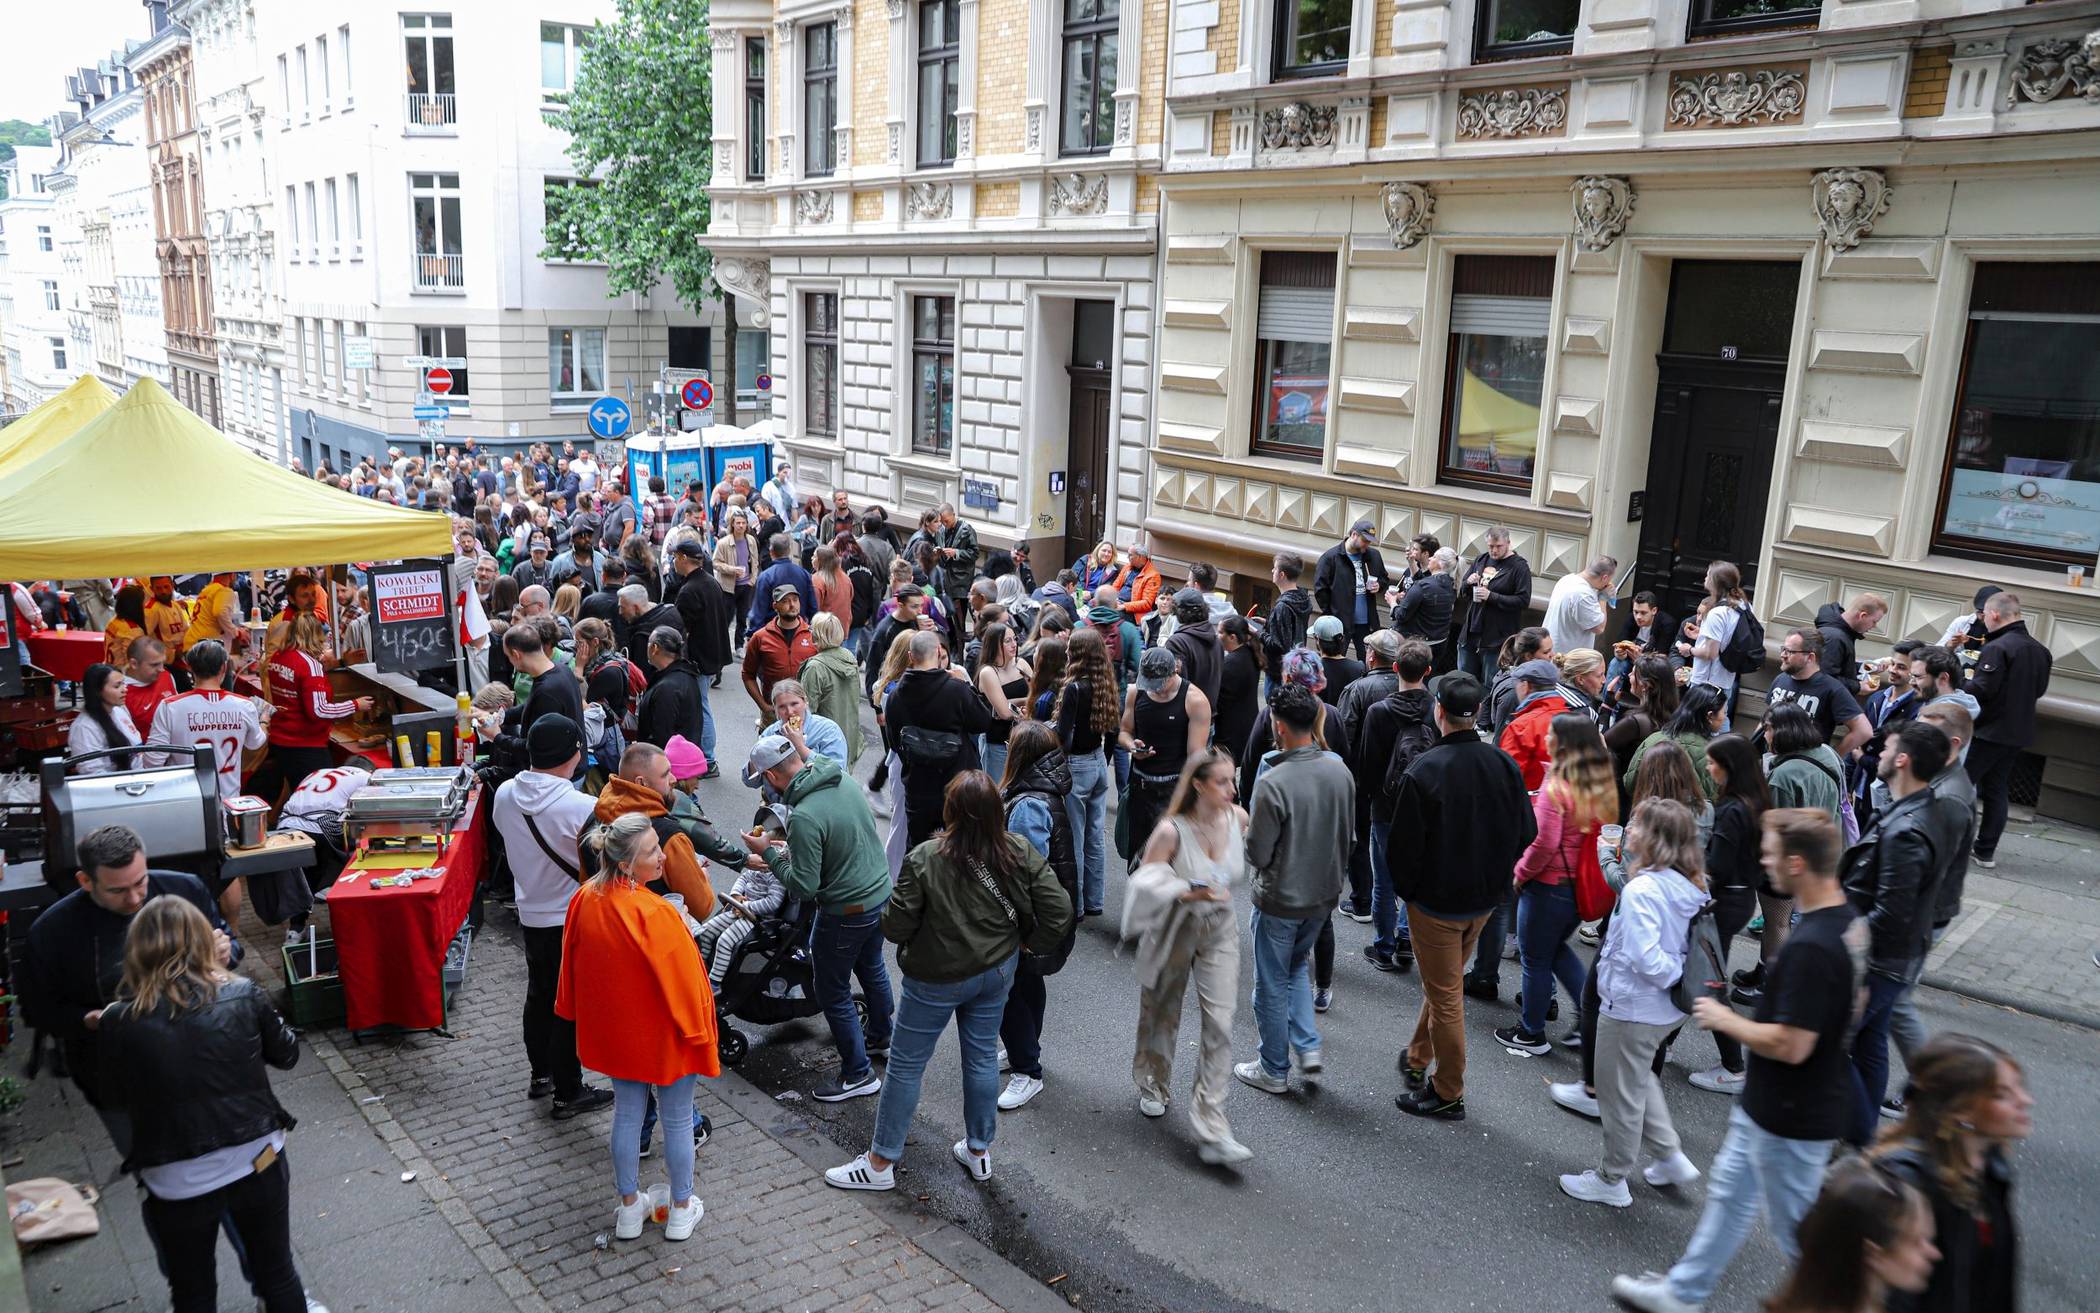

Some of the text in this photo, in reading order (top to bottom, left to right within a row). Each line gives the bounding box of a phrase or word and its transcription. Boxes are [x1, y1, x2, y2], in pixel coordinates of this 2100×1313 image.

[1722, 348, 1736, 359] 70
[728, 460, 752, 470] mobi
[377, 574, 439, 588] KOWALSKI
[383, 595, 439, 612] SCHMIDT
[187, 711, 243, 726] FC POLONIA
[189, 723, 242, 732] WUPPERTAL
[194, 735, 238, 774] 2
